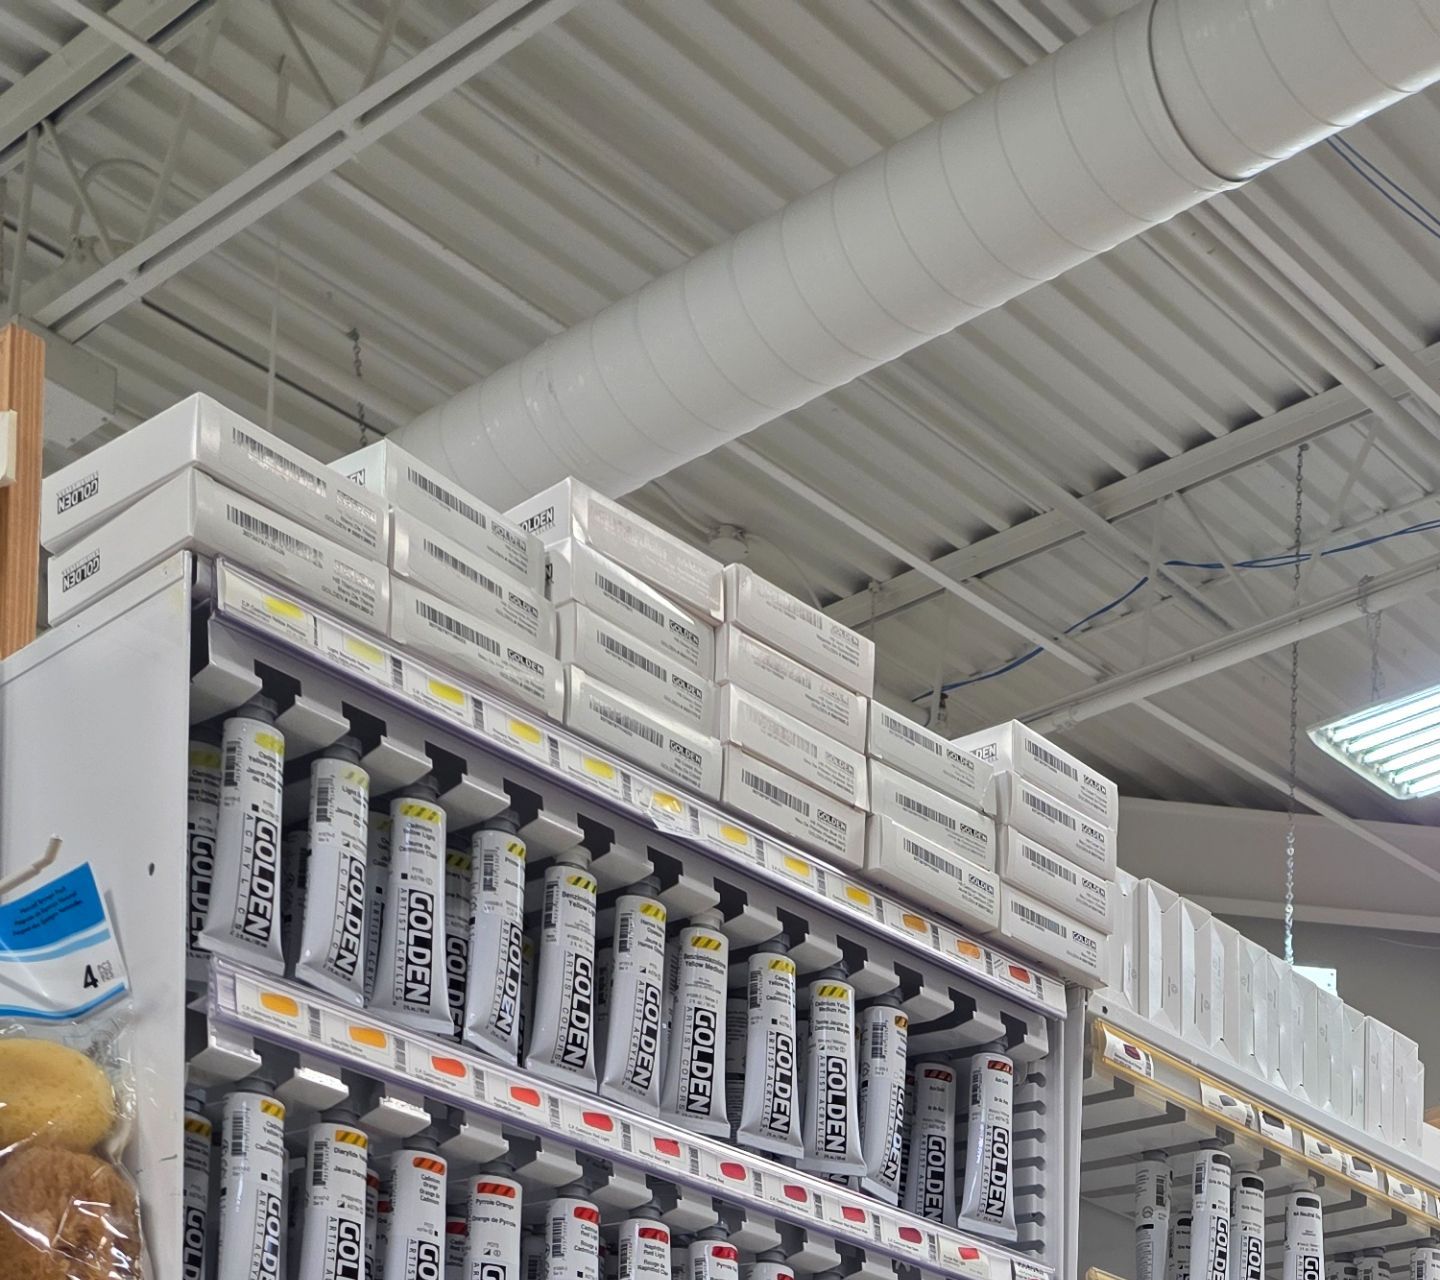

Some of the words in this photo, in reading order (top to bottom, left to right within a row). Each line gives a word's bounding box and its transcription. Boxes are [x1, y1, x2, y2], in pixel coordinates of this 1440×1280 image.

[83, 964, 98, 989] 4
[406, 890, 434, 1006] GOLDEN
[564, 953, 592, 1067] GOLDEN
[687, 1007, 716, 1115] GOLDEN
[818, 1056, 827, 1095] ARTIST
[825, 1055, 847, 1155] GOLDEN
